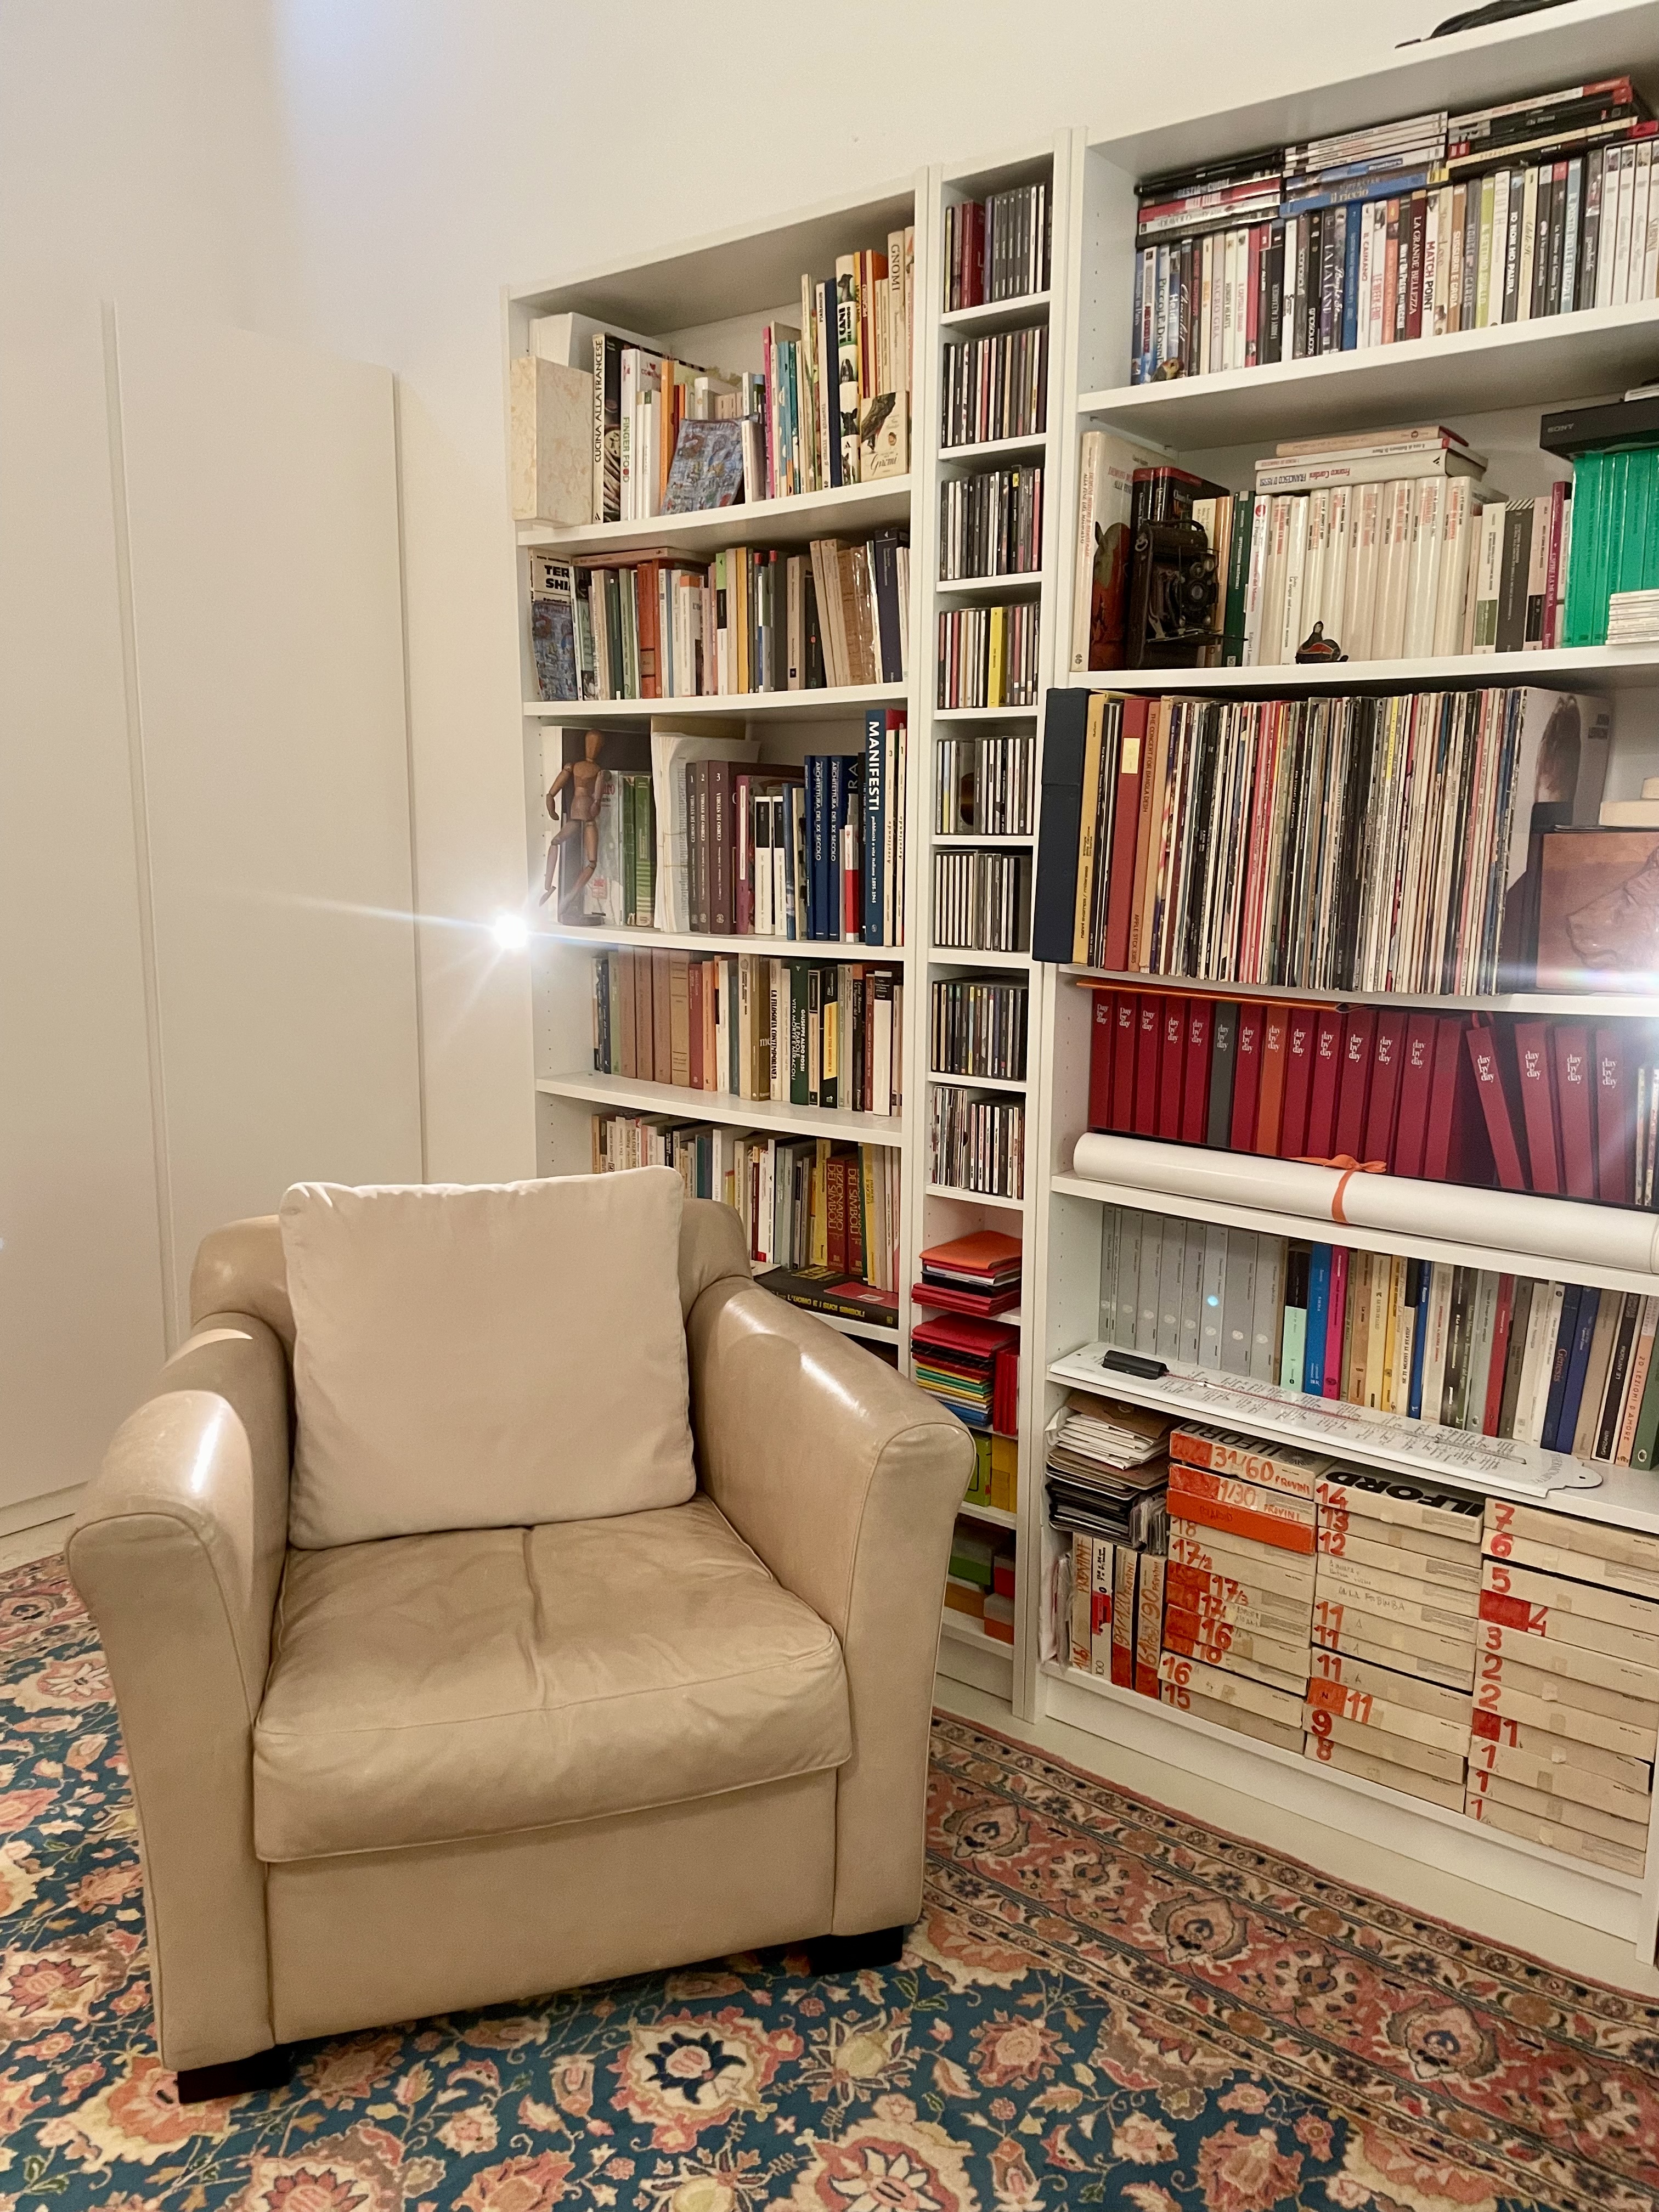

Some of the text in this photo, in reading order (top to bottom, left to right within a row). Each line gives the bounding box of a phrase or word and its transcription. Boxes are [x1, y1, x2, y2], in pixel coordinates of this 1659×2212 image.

[1331, 189, 1369, 204] il riccio
[1494, 176, 1508, 226] YOUTH
[1511, 212, 1518, 222] IO
[1509, 247, 1516, 262] HO
[891, 244, 900, 291] GNOMI
[1409, 216, 1422, 315] LA GRANDE BELLEZZA
[1424, 241, 1435, 311] MATCH POINT
[1506, 263, 1515, 295] PAURA
[1449, 282, 1460, 308] GRIDA
[1547, 422, 1575, 433] SONY
[1309, 471, 1330, 480] Cardini
[1330, 468, 1351, 476] Franco
[1278, 473, 1307, 484] FRANCESCO
[1147, 726, 1155, 755] CONCERT
[900, 747, 904, 755] 1
[868, 721, 879, 810] MANIFESTI
[716, 773, 721, 781] 3
[1097, 1004, 1109, 1012] Day
[1120, 1007, 1132, 1016] Day
[1097, 1016, 1107, 1024] day
[1169, 1017, 1179, 1027] day
[1193, 1019, 1204, 1029] day
[1169, 1024, 1176, 1034] by
[1192, 1026, 1200, 1036] by
[1218, 1024, 1229, 1034] day
[1269, 1025, 1280, 1034] day
[1294, 1029, 1306, 1038] day
[1168, 1033, 1178, 1043] day
[1192, 1035, 1203, 1046] day
[1218, 1032, 1226, 1042] by
[1268, 1033, 1278, 1043] by
[1294, 1036, 1303, 1046] by
[1321, 1031, 1334, 1041] day
[1380, 1036, 1392, 1046] day
[1217, 1041, 1228, 1051] day
[1268, 1041, 1280, 1052] day
[1321, 1039, 1330, 1049] by
[1380, 1045, 1389, 1054] by
[1293, 1045, 1305, 1057] day
[1320, 1047, 1333, 1059] day
[1525, 1051, 1539, 1060] day
[1379, 1054, 1391, 1065] day
[1477, 1055, 1491, 1065] day
[1526, 1059, 1538, 1070] by
[1567, 1054, 1582, 1063] day
[1479, 1063, 1489, 1073] by
[1567, 1062, 1579, 1073] by
[1481, 1072, 1494, 1083] day
[1527, 1068, 1542, 1080] day
[1567, 1072, 1583, 1084] day
[827, 1164, 837, 1229] DEI SIMBOLI
[836, 1164, 844, 1231] DIZIONARIO
[848, 1169, 858, 1234] DEI SIMBOLI
[787, 1294, 811, 1305] L'UOMO
[822, 1301, 838, 1311] SUOI
[839, 1306, 865, 1317] SIMBOLI
[1553, 1348, 1567, 1382] Genesis
[1615, 1372, 1621, 1380] LE
[1624, 1356, 1645, 1441] 20 LEZIONI D'AMORE
[1180, 1423, 1283, 1457] ILFORD
[1316, 1483, 1348, 1510] 14
[1325, 1471, 1486, 1517] ILFORD
[1264, 1504, 1300, 1521] PROVINI
[1495, 1503, 1515, 1531] 7
[1320, 1506, 1349, 1532] 13
[1319, 1531, 1346, 1556] 12
[1491, 1533, 1513, 1558] 6
[1492, 1567, 1511, 1593] 5
[1527, 1606, 1548, 1637] 4
[1201, 1616, 1234, 1650] 16
[1485, 1626, 1502, 1650] 3
[1163, 1655, 1193, 1685] 16
[1482, 1653, 1503, 1681] 2
[1165, 1684, 1190, 1709] 15
[1322, 1691, 1328, 1700] N
[1479, 1683, 1502, 1711] 2
[1347, 1691, 1373, 1724] 11
[1311, 1709, 1332, 1738] 9
[1503, 1720, 1517, 1748] 1
[1316, 1737, 1335, 1760] 8
[1481, 1745, 1496, 1769] 1
[1476, 1770, 1488, 1793] 1
[1470, 1799, 1482, 1820] 1
